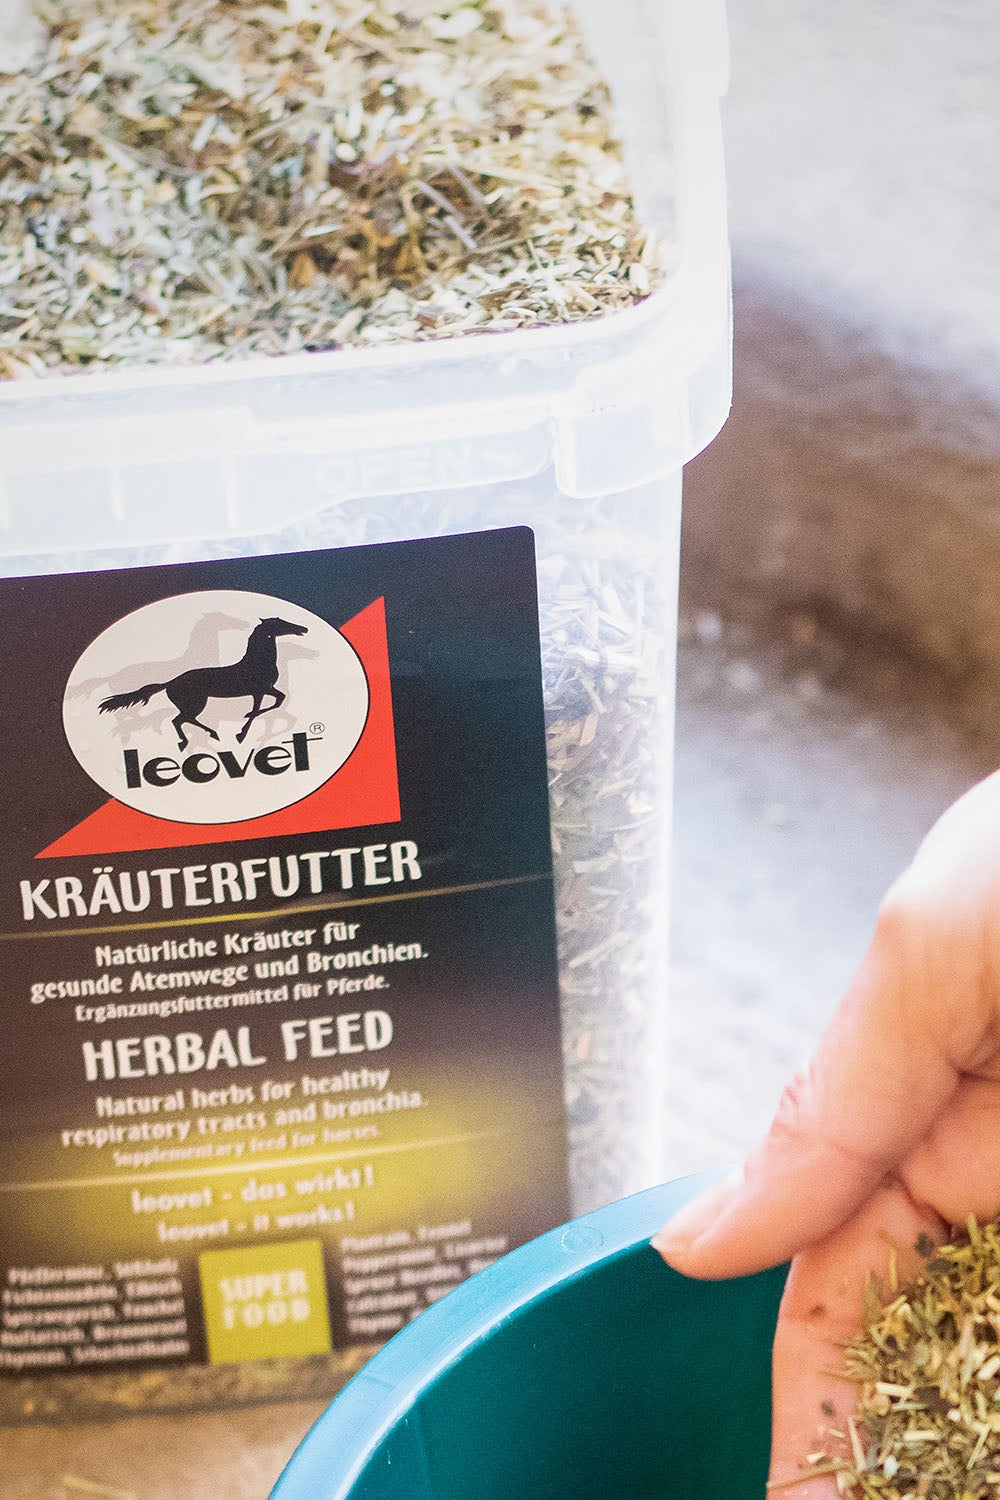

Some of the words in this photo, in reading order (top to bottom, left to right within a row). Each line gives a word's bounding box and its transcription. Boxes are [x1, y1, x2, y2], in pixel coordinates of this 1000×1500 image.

[314, 443, 473, 494] OPEN
[123, 731, 323, 789] leovet
[19, 840, 422, 921] KRÄUTERFUTTER
[95, 936, 217, 968] Natürliche
[224, 927, 317, 956] Kräuter
[323, 922, 360, 946] für
[31, 974, 122, 1004] gesunde
[131, 967, 249, 993] Atemwege
[256, 957, 299, 979] und
[307, 943, 429, 973] Bronchien.
[75, 982, 289, 1023] Ergänzungsfuttermittel
[293, 977, 321, 1000] für
[327, 973, 391, 996] Pferde.
[82, 1027, 266, 1081] HERBAL
[282, 1010, 394, 1060] FEED
[96, 1088, 184, 1117] Natural
[192, 1081, 254, 1109] herbs
[262, 1076, 295, 1102] for
[302, 1068, 390, 1096] healthy
[61, 1116, 190, 1149] respiratory
[197, 1109, 266, 1134] tracts
[274, 1101, 316, 1126] and
[323, 1090, 428, 1122] bronchia.
[113, 1139, 245, 1168] Supplementary
[250, 1133, 286, 1153] feed
[291, 1129, 316, 1150] for
[132, 1186, 213, 1214] leovet
[241, 1178, 287, 1203] das
[219, 1269, 308, 1301] SUPER
[222, 1297, 311, 1330] FOOD
